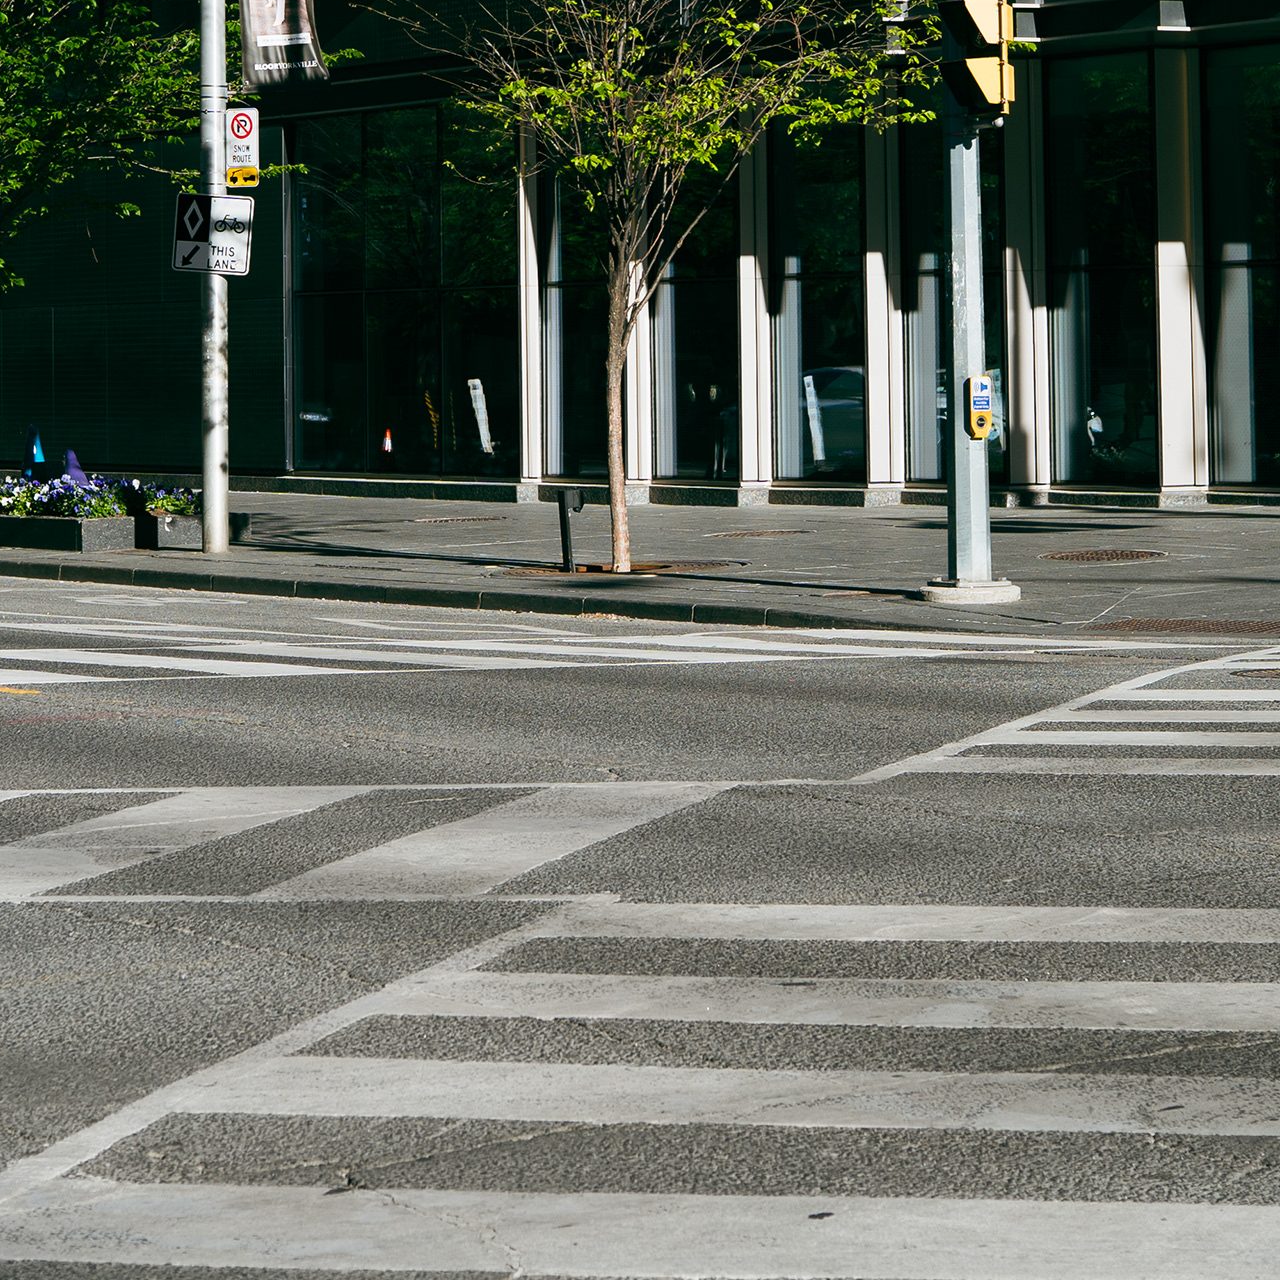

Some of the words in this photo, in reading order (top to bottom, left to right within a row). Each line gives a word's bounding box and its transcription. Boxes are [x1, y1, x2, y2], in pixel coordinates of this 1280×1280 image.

[233, 144, 251, 153] SNOW
[232, 154, 251, 163] ROUTE
[211, 245, 235, 257] THIS
[206, 257, 237, 270] LANE
